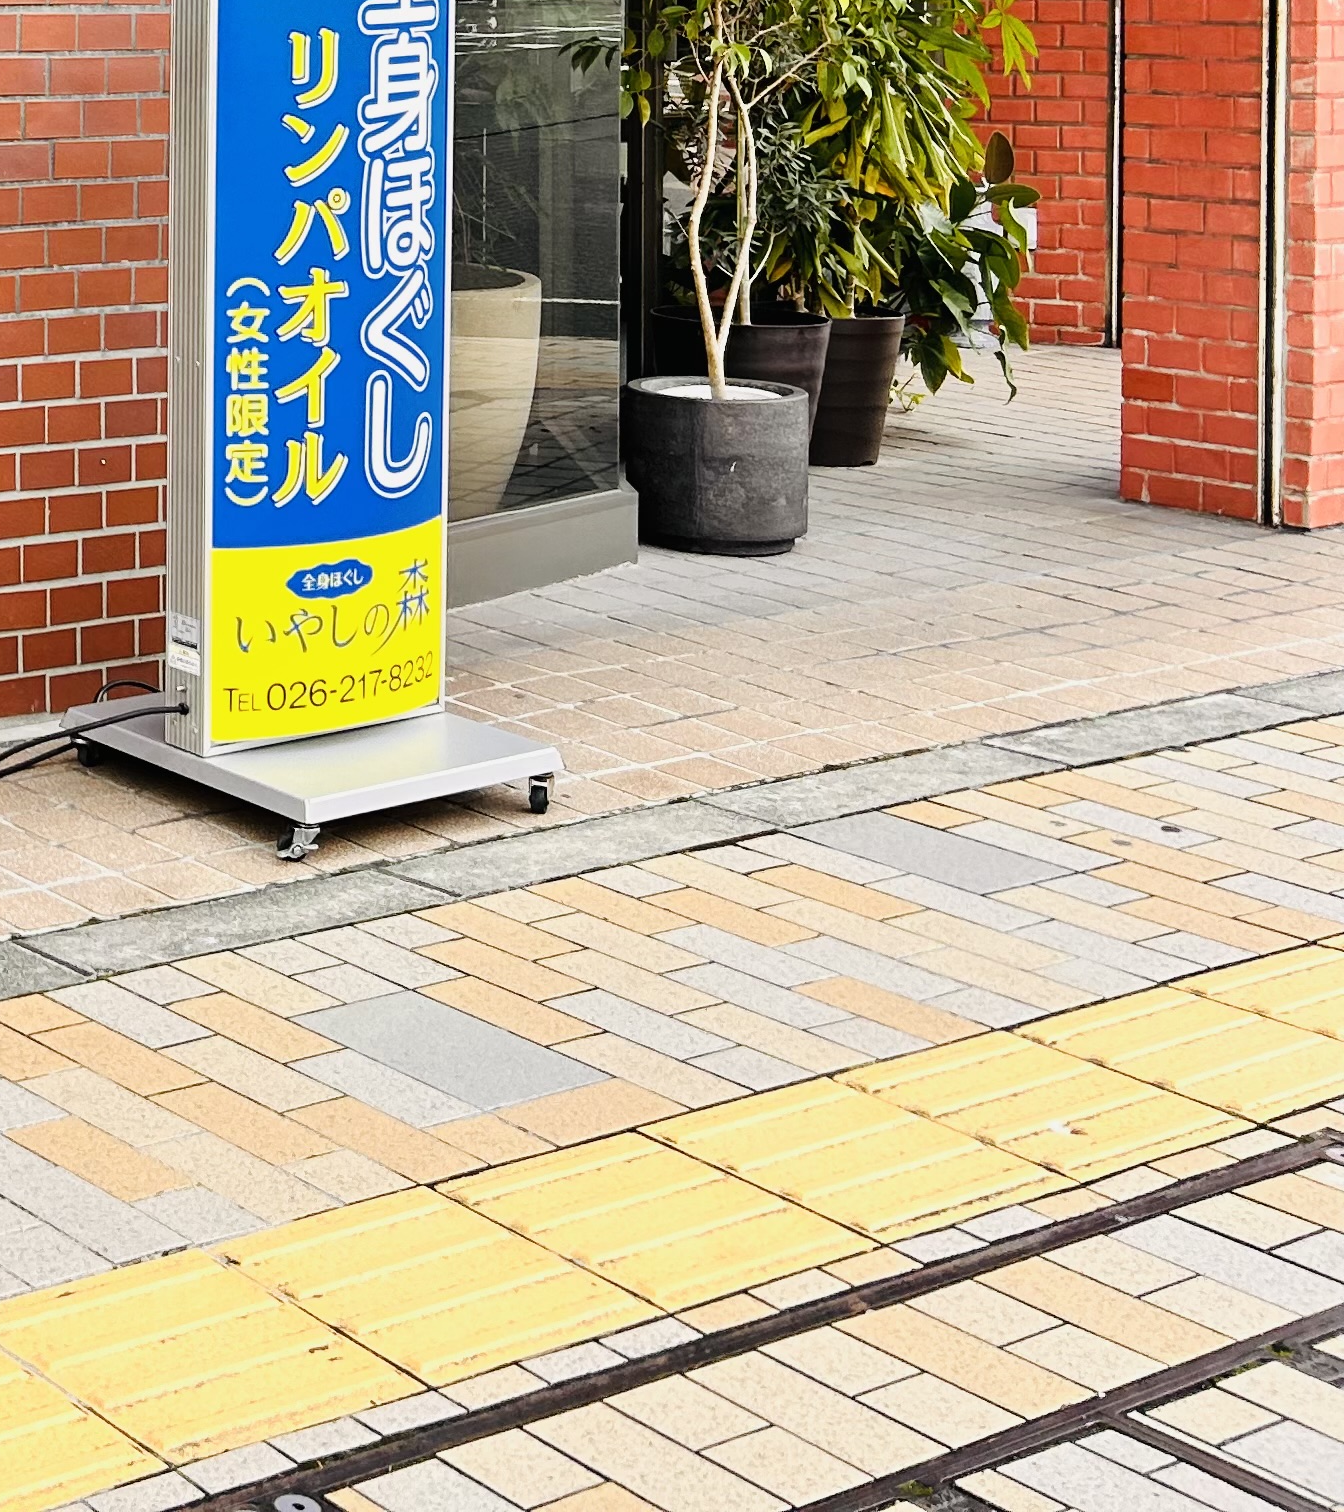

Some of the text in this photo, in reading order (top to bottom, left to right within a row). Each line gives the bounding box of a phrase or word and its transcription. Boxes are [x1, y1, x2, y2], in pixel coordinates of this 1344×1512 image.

[272, 27, 350, 509] リンパオイル
[225, 277, 271, 507] (女性限定)
[236, 558, 430, 656] いやしの森
[301, 567, 364, 592] 全身ほぐし
